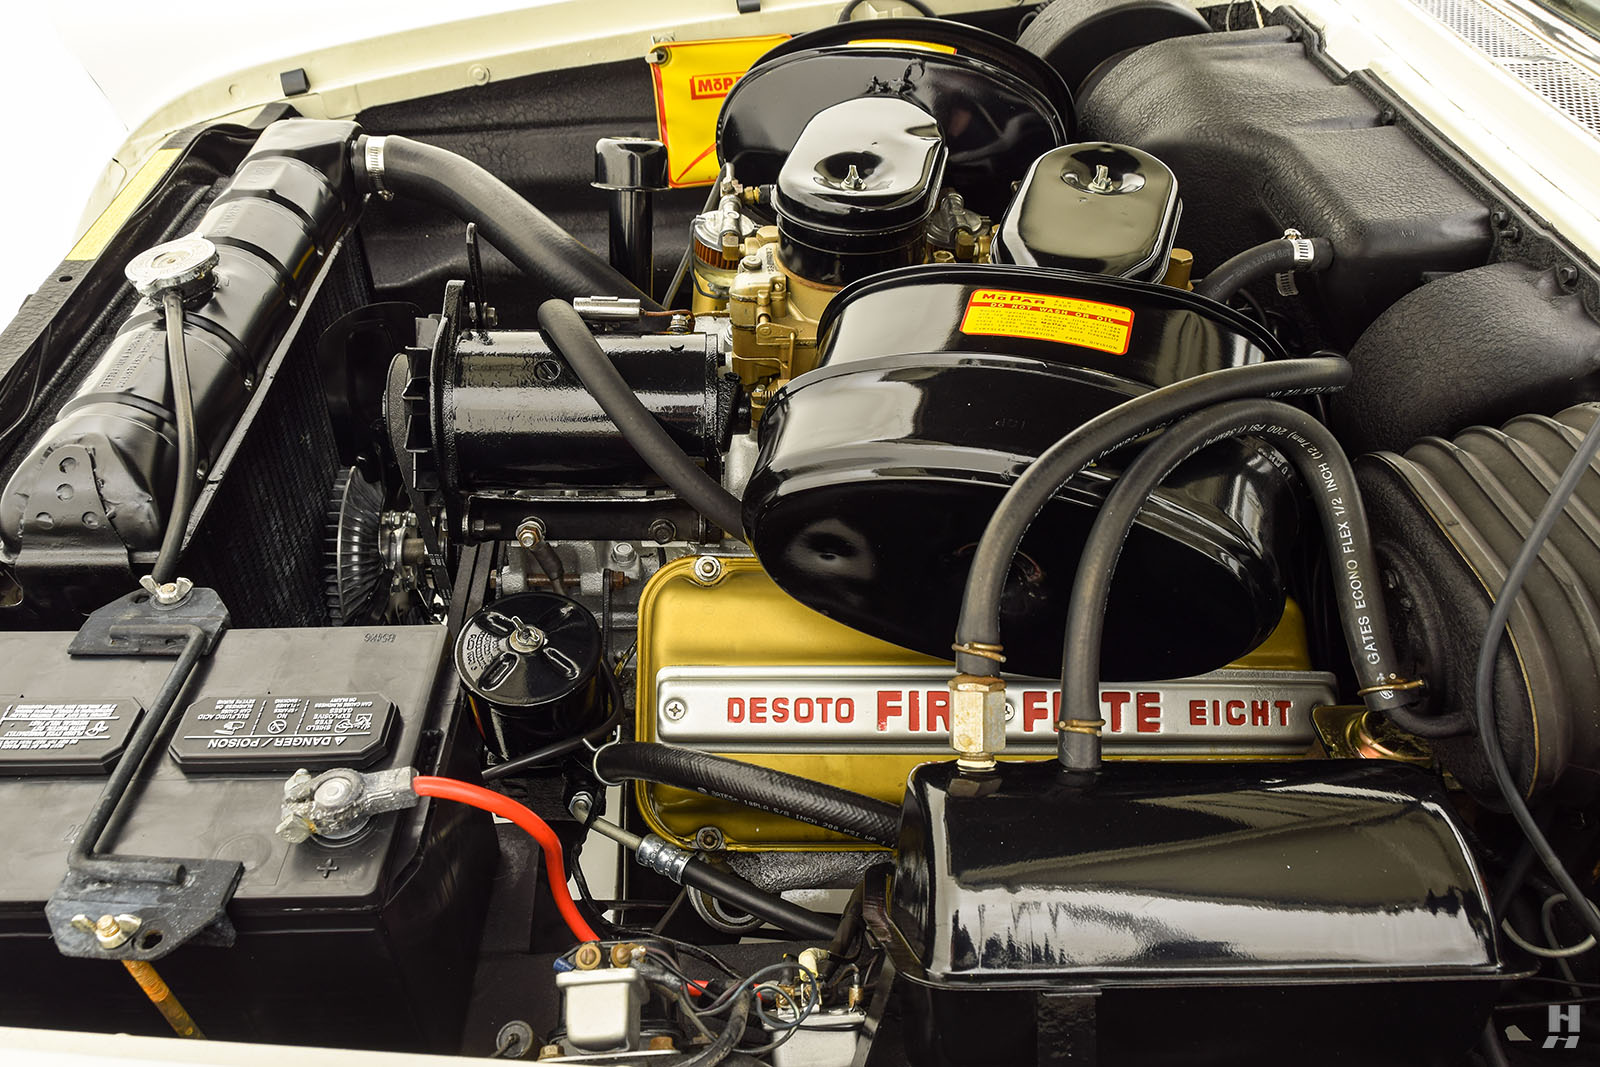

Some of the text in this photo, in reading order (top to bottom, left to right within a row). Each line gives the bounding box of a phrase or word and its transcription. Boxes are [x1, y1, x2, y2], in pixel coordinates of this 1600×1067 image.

[698, 76, 742, 92] MōP
[1040, 307, 1068, 316] WASH
[1247, 423, 1266, 432] PSI
[1266, 425, 1288, 435] 200
[1287, 431, 1324, 460] (12.7mm)
[1319, 462, 1339, 493] INCH
[1331, 496, 1346, 517] 1/2
[1337, 520, 1356, 554] FLEX
[1346, 559, 1367, 609] ECONO
[1357, 616, 1381, 665] GATES
[727, 690, 1294, 733] DESOTO FIR FTE EIGHT
[207, 738, 260, 748] POISON
[273, 737, 331, 746] DANGER
[795, 814, 819, 825] INCH
[842, 828, 861, 838] PSI
